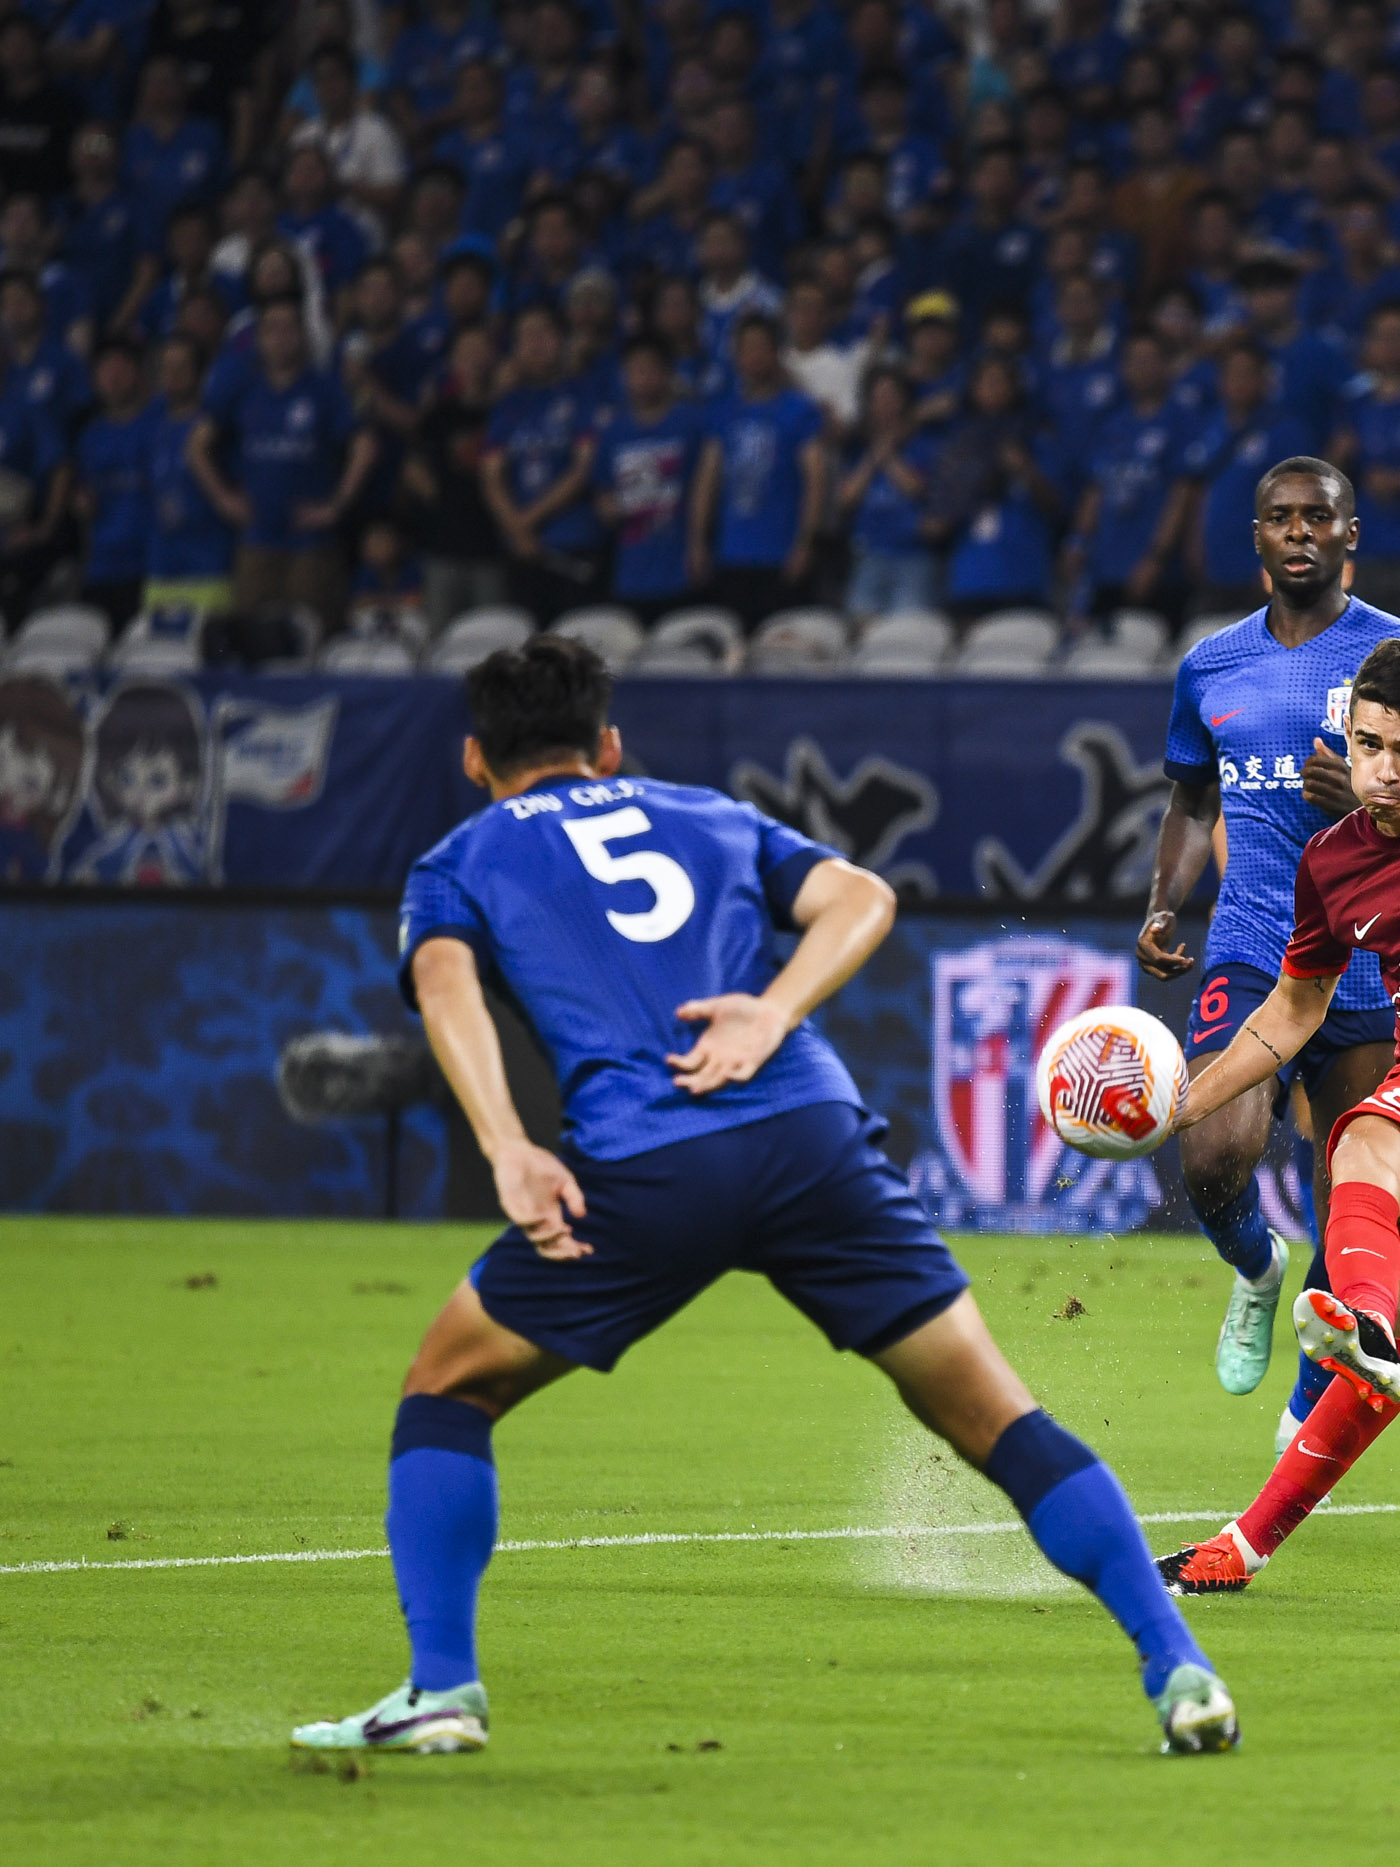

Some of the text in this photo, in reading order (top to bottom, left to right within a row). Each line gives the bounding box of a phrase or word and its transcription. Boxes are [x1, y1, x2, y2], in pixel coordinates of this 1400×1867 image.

[1244, 754, 1301, 781] 交通
[1264, 780, 1280, 790] OF
[561, 805, 695, 943] 5
[1200, 976, 1229, 1022] 6
